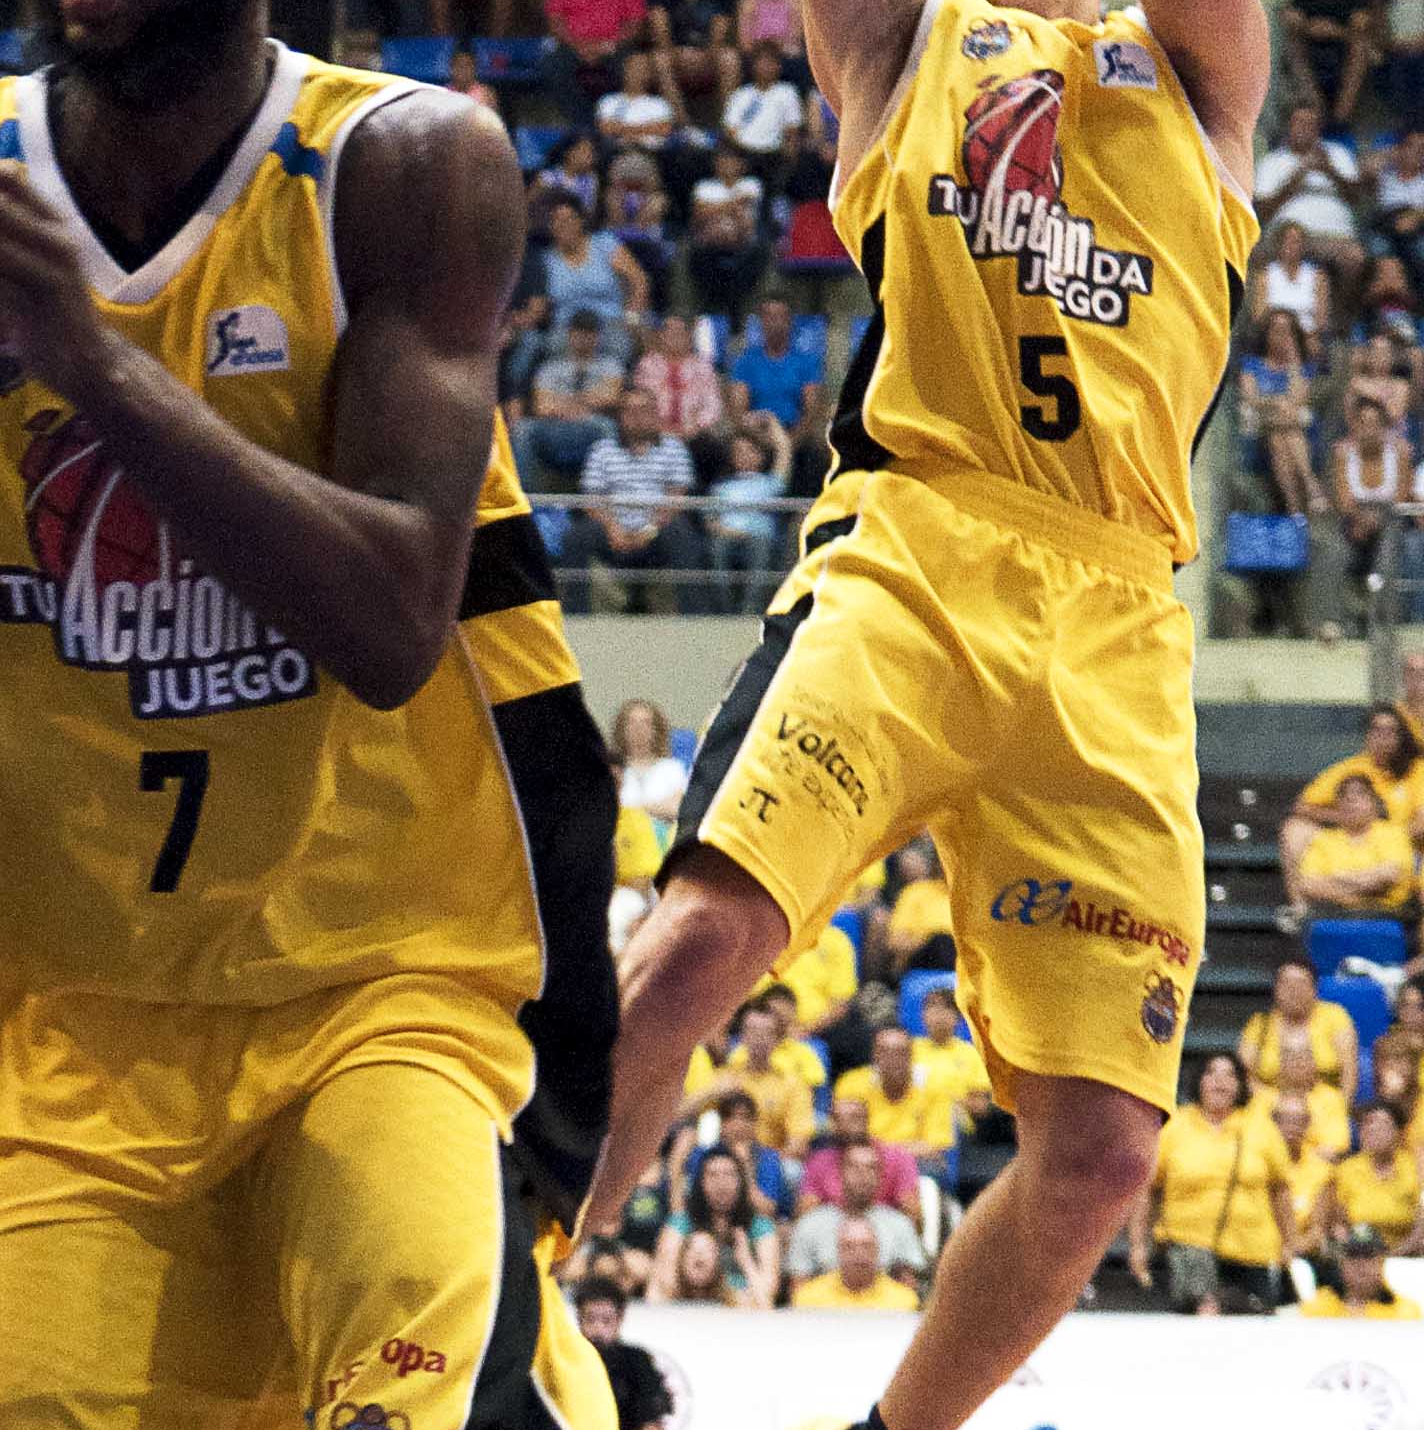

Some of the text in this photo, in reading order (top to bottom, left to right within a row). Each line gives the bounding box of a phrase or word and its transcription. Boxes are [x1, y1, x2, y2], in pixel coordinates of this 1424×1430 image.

[1092, 251, 1150, 294] DA
[1018, 336, 1079, 441] 5
[140, 648, 310, 714] JUEGO
[139, 748, 210, 894] 7
